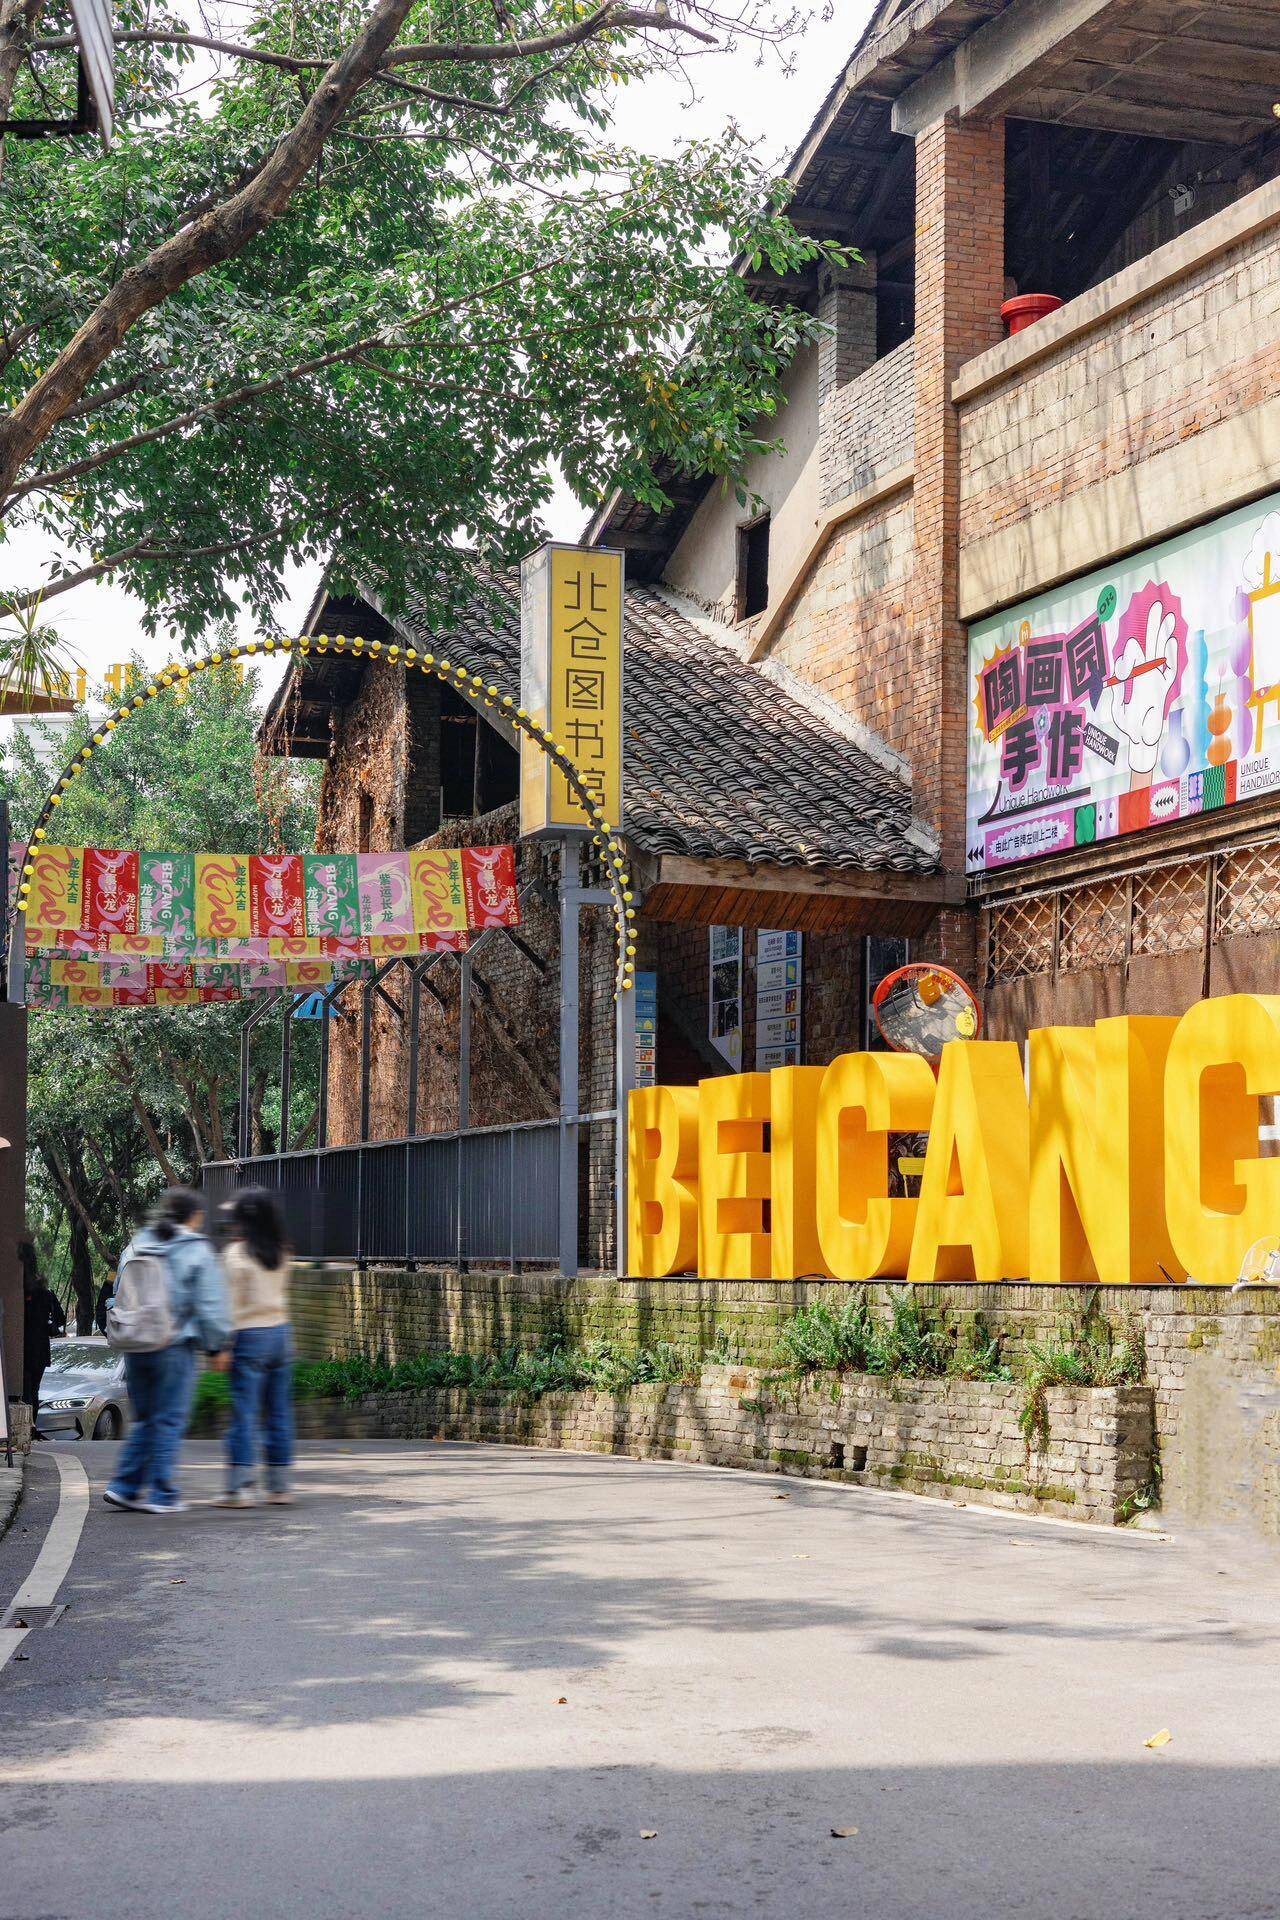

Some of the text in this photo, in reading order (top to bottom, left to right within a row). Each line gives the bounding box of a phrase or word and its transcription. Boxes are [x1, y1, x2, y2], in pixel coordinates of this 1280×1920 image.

[563, 570, 607, 807] 北仓图书馆
[1003, 710, 1083, 785] 手作
[1084, 735, 1116, 762] HANDWORK
[1087, 725, 1108, 746] UNIQUE
[1240, 757, 1269, 775] UNIQUE
[998, 784, 1069, 812] Unique Handwork
[995, 826, 1058, 853] 由此广告牌左侧上二楼
[161, 862, 173, 919] BEICANG
[325, 864, 339, 921] BEICANG
[627, 993, 1280, 1285] BEICANG
